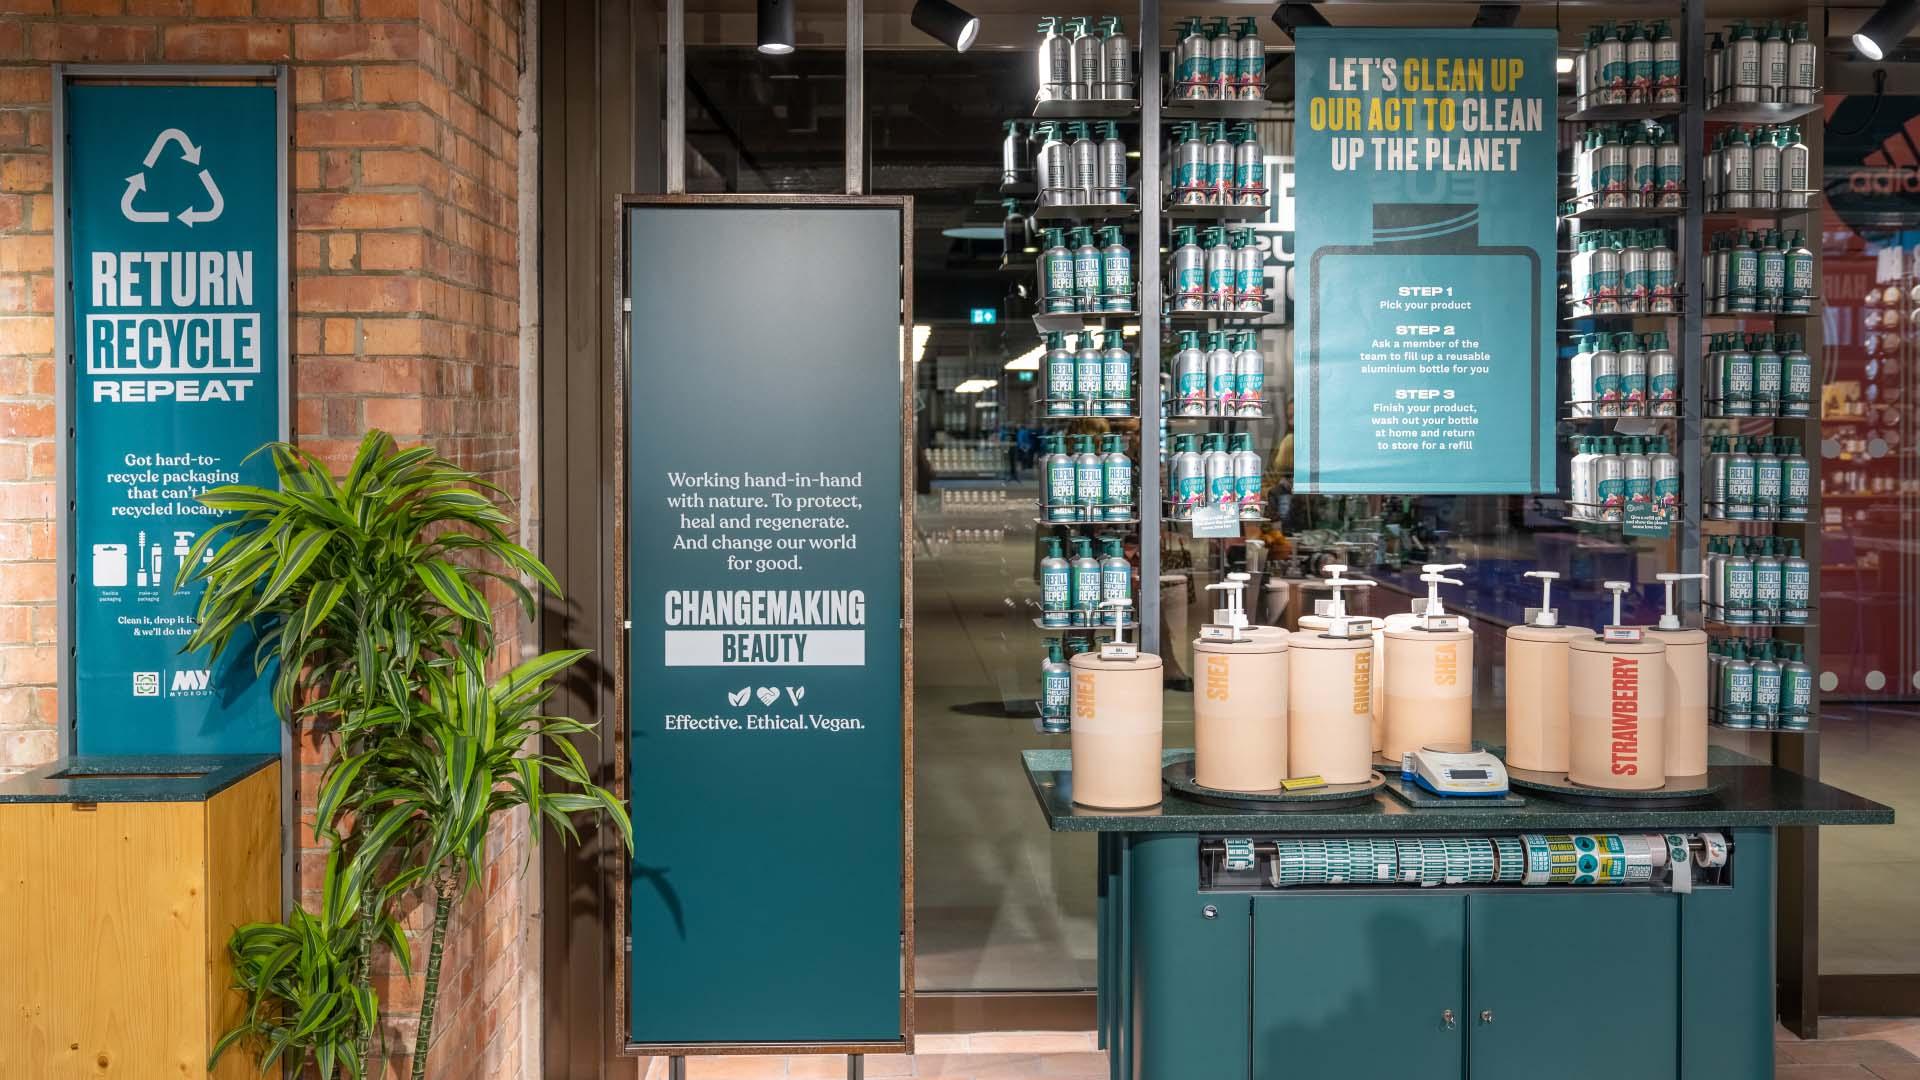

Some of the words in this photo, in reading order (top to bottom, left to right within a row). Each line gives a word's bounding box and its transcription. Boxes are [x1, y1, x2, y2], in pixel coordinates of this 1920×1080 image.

[1329, 58, 1397, 91] LET'S
[1404, 59, 1483, 94] CLEAN
[1491, 59, 1523, 92] UP
[1311, 98, 1361, 131] OUR
[1367, 97, 1416, 132] ACT
[1422, 98, 1455, 134] TO
[1460, 96, 1542, 131] CLEAN
[1332, 138, 1364, 170] UP
[1372, 138, 1418, 170] THE
[1423, 138, 1520, 171] PLANET
[92, 251, 252, 306] RETURN
[1399, 287, 1443, 296] STEP
[1447, 287, 1452, 296] 1
[1380, 300, 1402, 309] Pick
[1405, 303, 1428, 311] your
[1431, 301, 1471, 311] product
[1396, 326, 1440, 335] STEP
[1444, 326, 1455, 335] 2
[93, 318, 253, 369] RECYCLE
[1372, 339, 1390, 348] Ask
[1403, 339, 1445, 348] member
[1449, 339, 1459, 347] of
[1462, 340, 1479, 348] the
[1405, 352, 1418, 360] fill
[1421, 354, 1433, 363] up
[1446, 352, 1490, 360] reusable
[1361, 364, 1415, 373] aluminium
[1420, 364, 1449, 373] bottle
[1453, 364, 1468, 373] for
[1470, 367, 1488, 375] you
[94, 380, 253, 402] REPEAT
[1395, 389, 1440, 399] STEP
[1443, 390, 1454, 399] 3
[1374, 403, 1404, 412] Finish
[1408, 406, 1431, 414] your
[1434, 403, 1477, 414] product,
[1372, 416, 1398, 424] wash
[1423, 418, 1445, 428] your
[1448, 416, 1478, 424] bottle
[1376, 429, 1385, 437] at
[1389, 428, 1417, 437] home
[1421, 428, 1439, 437] and
[1443, 429, 1474, 437] return
[1422, 441, 1436, 449] for
[1449, 441, 1472, 449] refill
[125, 454, 152, 466] Got
[156, 453, 220, 465] hard-to-
[108, 470, 159, 485] recycle
[163, 469, 239, 485] packaging
[668, 472, 739, 489] Working
[745, 472, 861, 487] hand-in-hand
[128, 487, 158, 499] that
[161, 486, 197, 499] can't
[112, 503, 172, 518] recycled
[177, 503, 232, 518] locay
[667, 493, 704, 507] with
[709, 496, 768, 507] nature.
[772, 493, 792, 507] To
[797, 496, 862, 511] protect,
[681, 513, 714, 528] heal
[720, 514, 750, 528] and
[756, 516, 848, 531] regenerate.
[674, 535, 707, 549] And
[712, 534, 772, 551] change
[777, 539, 806, 549] our
[809, 534, 856, 549] world
[728, 555, 752, 569] for
[756, 555, 802, 572] good.
[665, 590, 865, 625] CHANGEMAKING
[118, 616, 141, 624] Clean
[144, 616, 152, 625] it,
[154, 616, 175, 625] drop
[722, 634, 807, 662] BEAUTY
[1435, 644, 1457, 686] SHEA
[171, 670, 210, 690] MY
[1048, 679, 1069, 689] REFILL
[1207, 655, 1229, 702] SHEA
[1354, 652, 1370, 714] GINGER
[1076, 672, 1095, 719] SHEA
[666, 715, 742, 729] Effective.
[747, 715, 810, 729] Ethical.
[809, 715, 864, 732] Vegan.
[1611, 657, 1639, 776] STRAWBERRY
